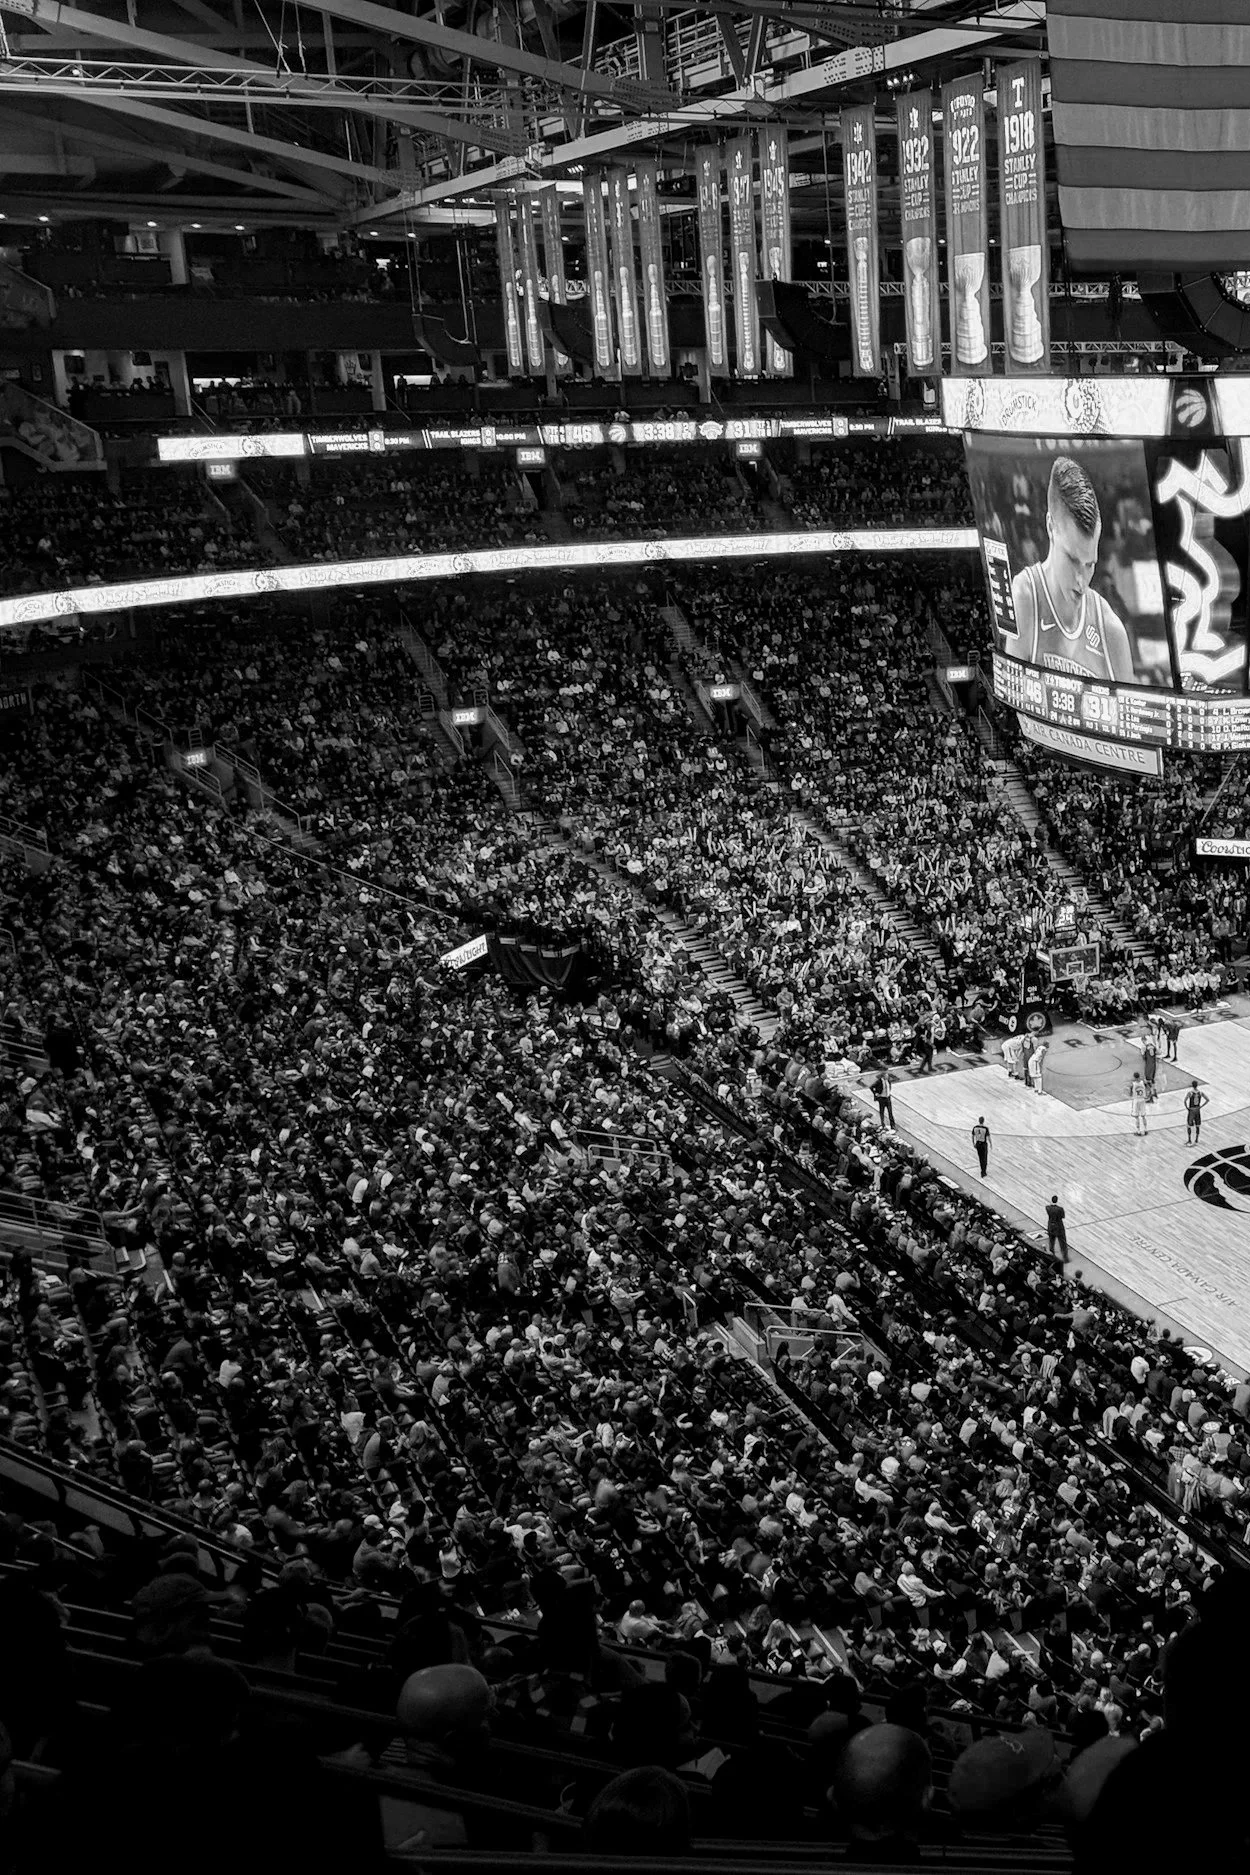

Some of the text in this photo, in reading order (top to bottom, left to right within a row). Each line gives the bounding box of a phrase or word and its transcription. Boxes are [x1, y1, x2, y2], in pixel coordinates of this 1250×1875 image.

[1004, 110, 1035, 154] 1918
[949, 125, 979, 165] 922
[902, 135, 930, 174] 1932
[1004, 153, 1036, 174] STANLEY
[846, 149, 872, 185] 1942
[1013, 172, 1028, 190] CUP
[1002, 394, 1037, 426] DRUMSTICK
[573, 425, 592, 443] 46
[643, 423, 675, 441] 3:38
[734, 420, 752, 438] 31
[311, 434, 368, 443] TIMBERWOLVES
[326, 442, 369, 451] MAVERICKS
[519, 450, 542, 461] IBM
[738, 444, 758, 453] IBM
[210, 464, 231, 475] IBM
[949, 669, 967, 680] IBM
[712, 687, 731, 698] IBM
[1051, 690, 1075, 713] 3:38
[455, 711, 477, 723] IBM
[1087, 695, 1112, 722] 31
[1050, 726, 1092, 752] CANADA
[1095, 742, 1146, 764] CENTRE
[187, 754, 204, 765] IBM
[1171, 1262, 1218, 1293] CANADA
